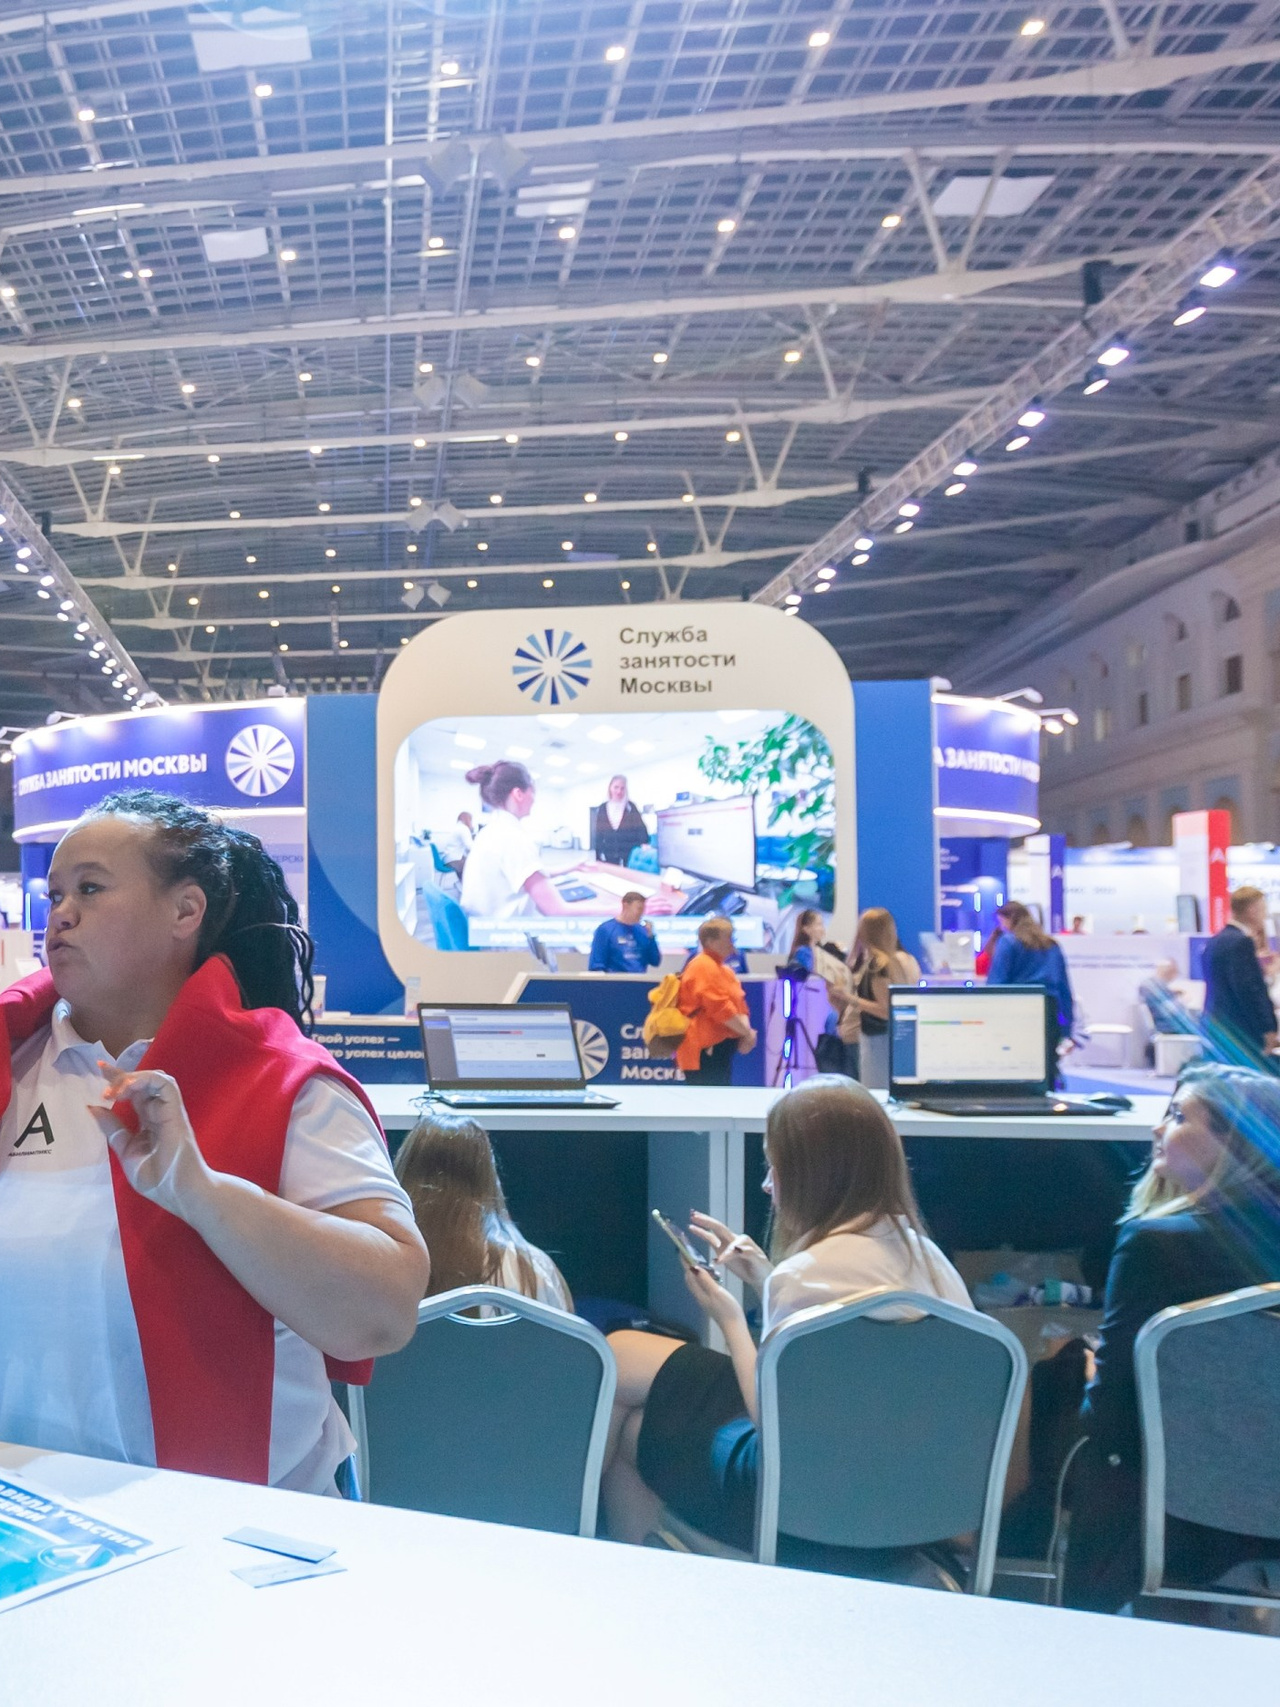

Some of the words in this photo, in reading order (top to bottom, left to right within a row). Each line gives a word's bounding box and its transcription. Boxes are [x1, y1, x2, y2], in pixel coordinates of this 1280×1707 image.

[619, 625, 708, 648] Служба
[619, 654, 736, 669] занятости
[621, 677, 712, 694] Москвы
[46, 760, 121, 789] ЗАНЯТОСТИ
[123, 753, 208, 779] МОСКВЫ
[345, 1036, 385, 1045] успех
[345, 1050, 385, 1060] успех
[621, 1065, 686, 1081] Москв
[52, 1506, 145, 1549] УЧАСТИЯ
